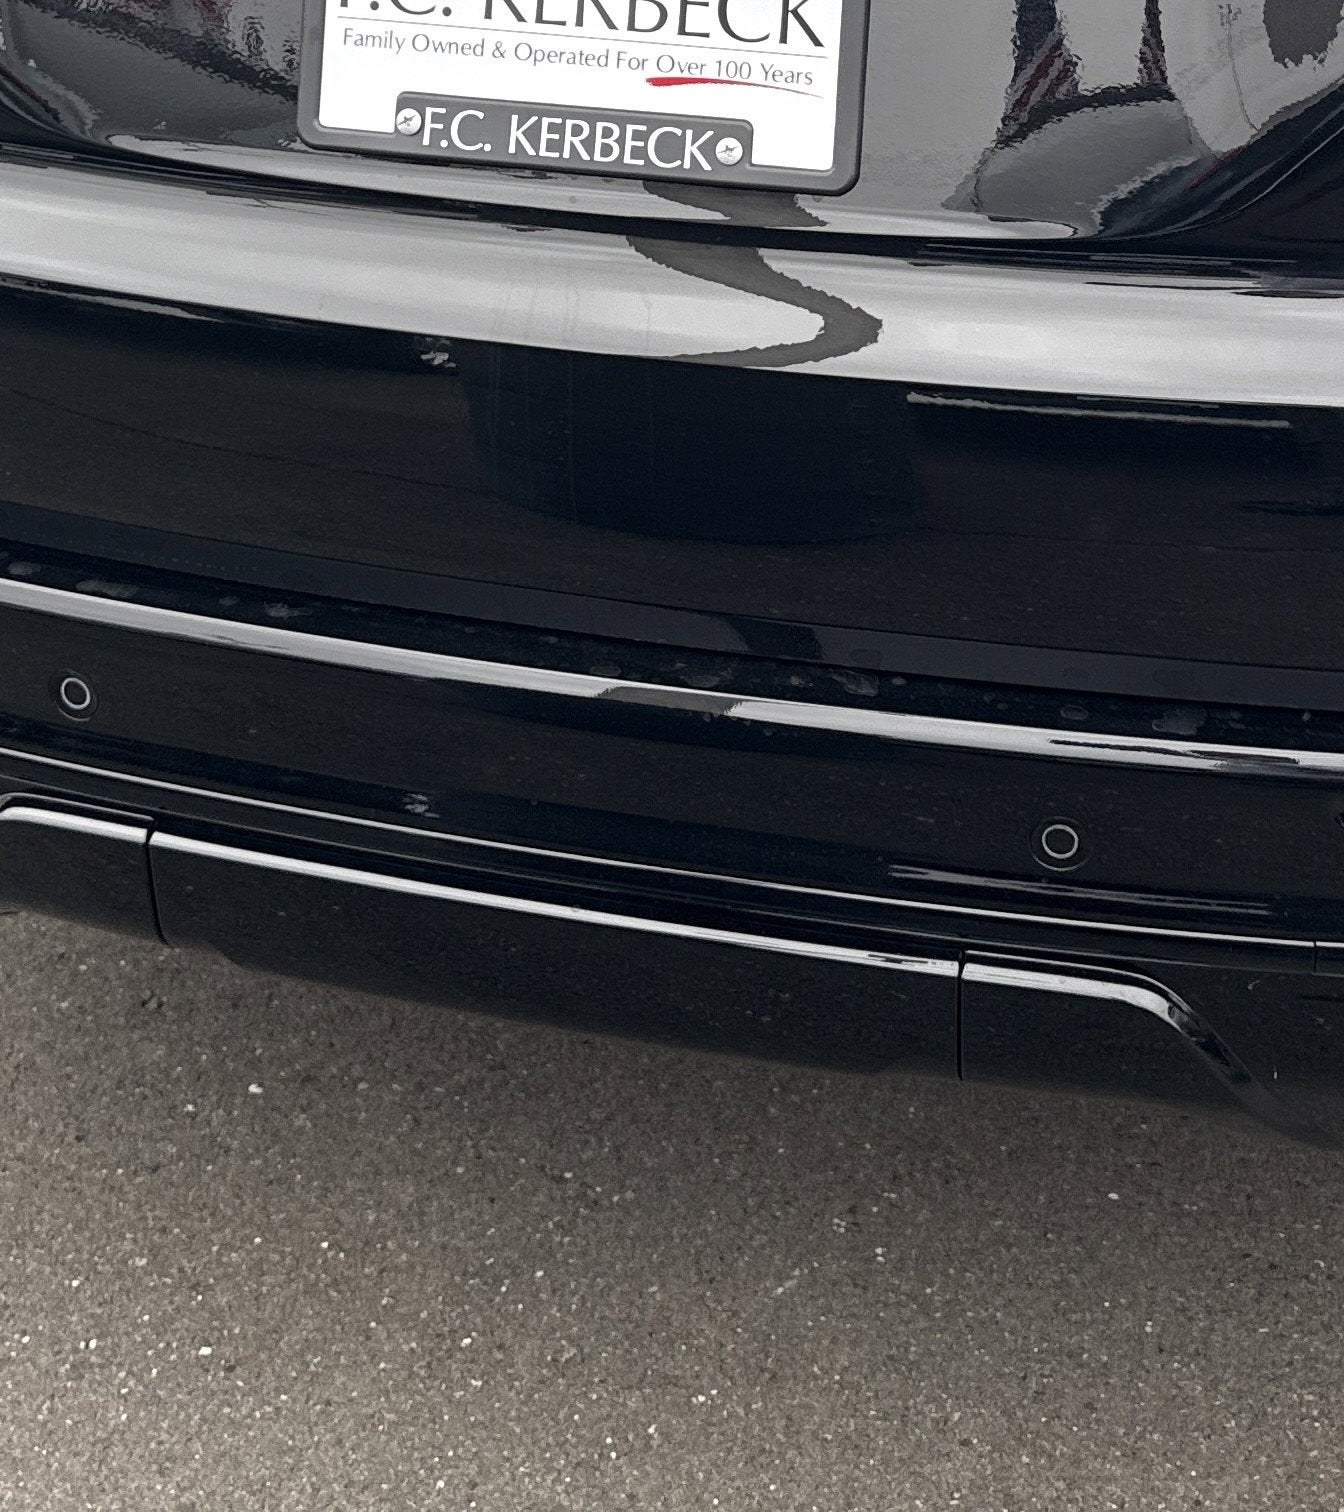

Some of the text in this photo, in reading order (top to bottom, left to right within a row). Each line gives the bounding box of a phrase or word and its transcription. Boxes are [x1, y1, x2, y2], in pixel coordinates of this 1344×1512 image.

[343, 28, 813, 86] Family Owned & Operated For Over 100 Years
[422, 106, 715, 171] F.C. KERBECK
